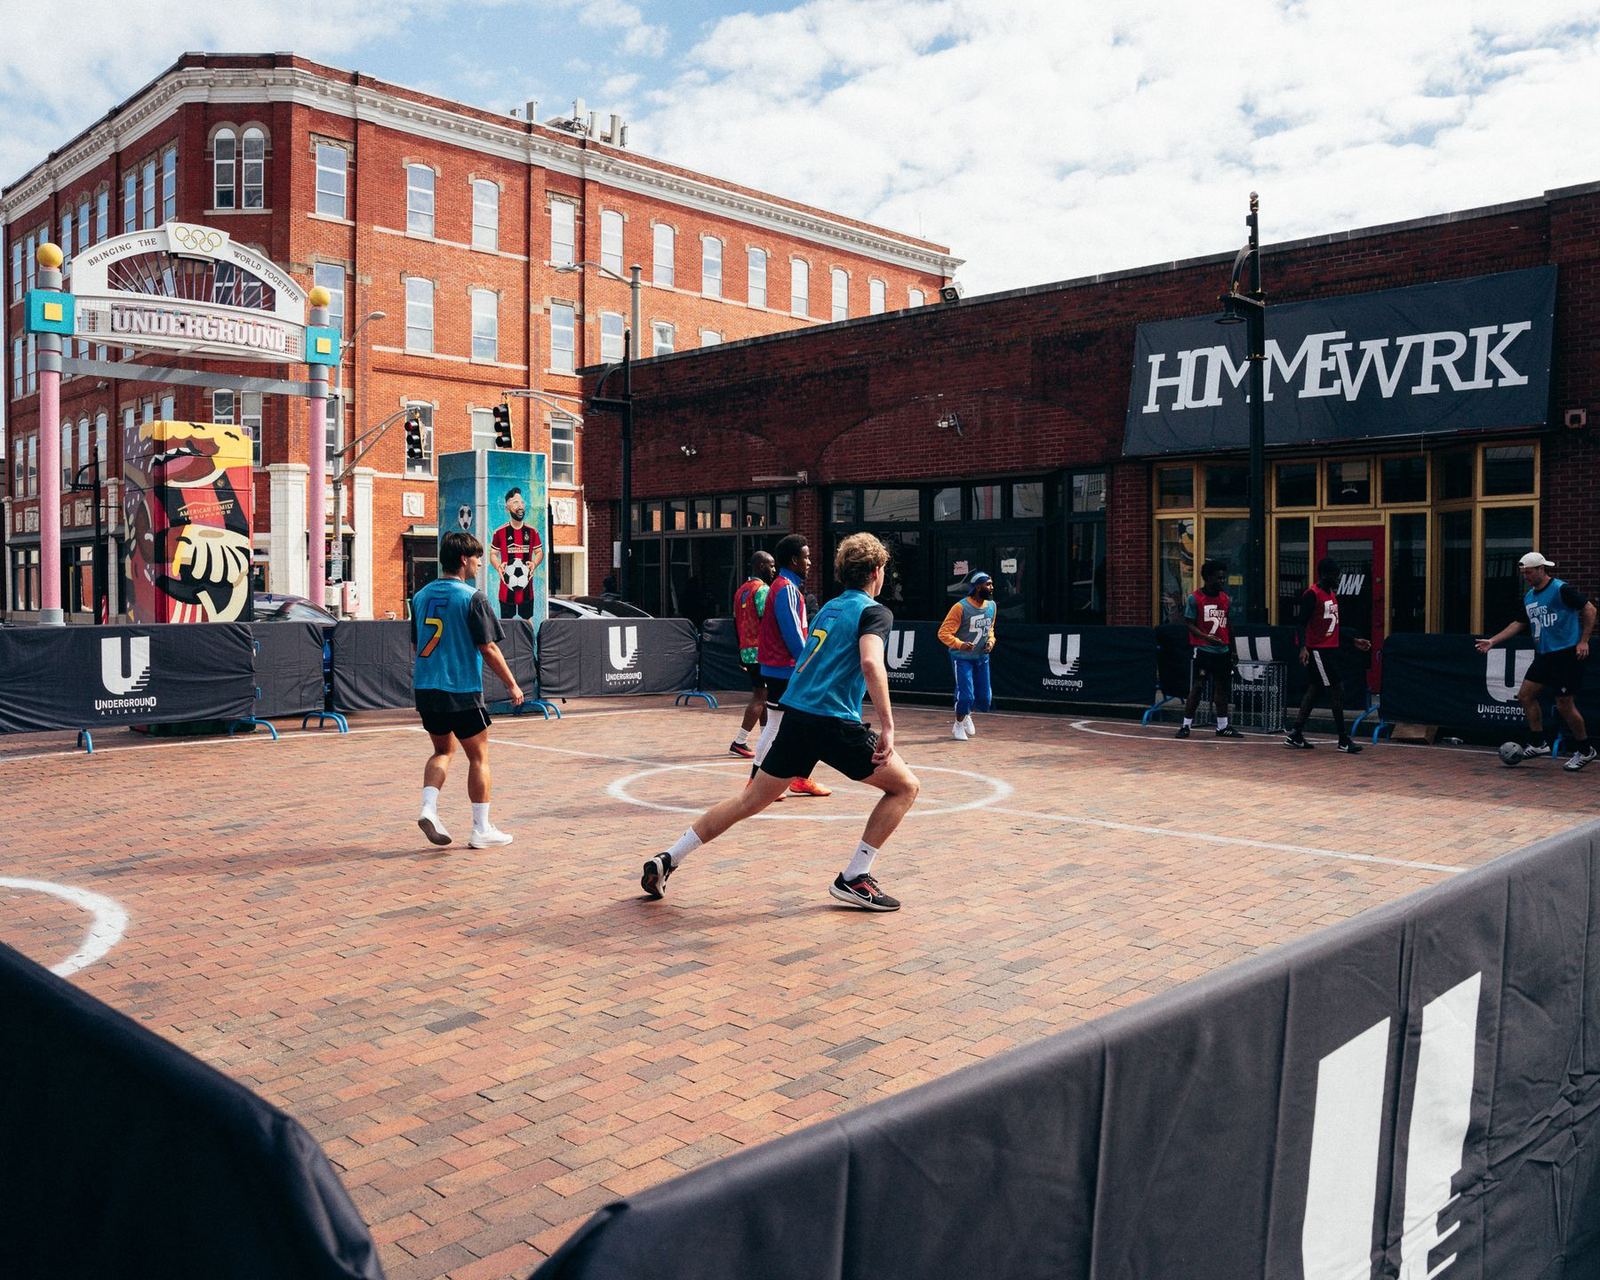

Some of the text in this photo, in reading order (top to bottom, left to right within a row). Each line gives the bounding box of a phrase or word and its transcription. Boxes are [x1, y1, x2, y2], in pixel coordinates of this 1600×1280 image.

[88, 238, 157, 266] BRINGING THE
[233, 251, 299, 303] WORLD TOGETHER
[112, 308, 285, 351] UNDERGROUND
[213, 502, 234, 512] FAMILY
[1203, 604, 1220, 636] 5
[1324, 599, 1336, 635] 5
[95, 696, 157, 710] UNDERGROUND
[101, 707, 151, 716] ATLANTA
